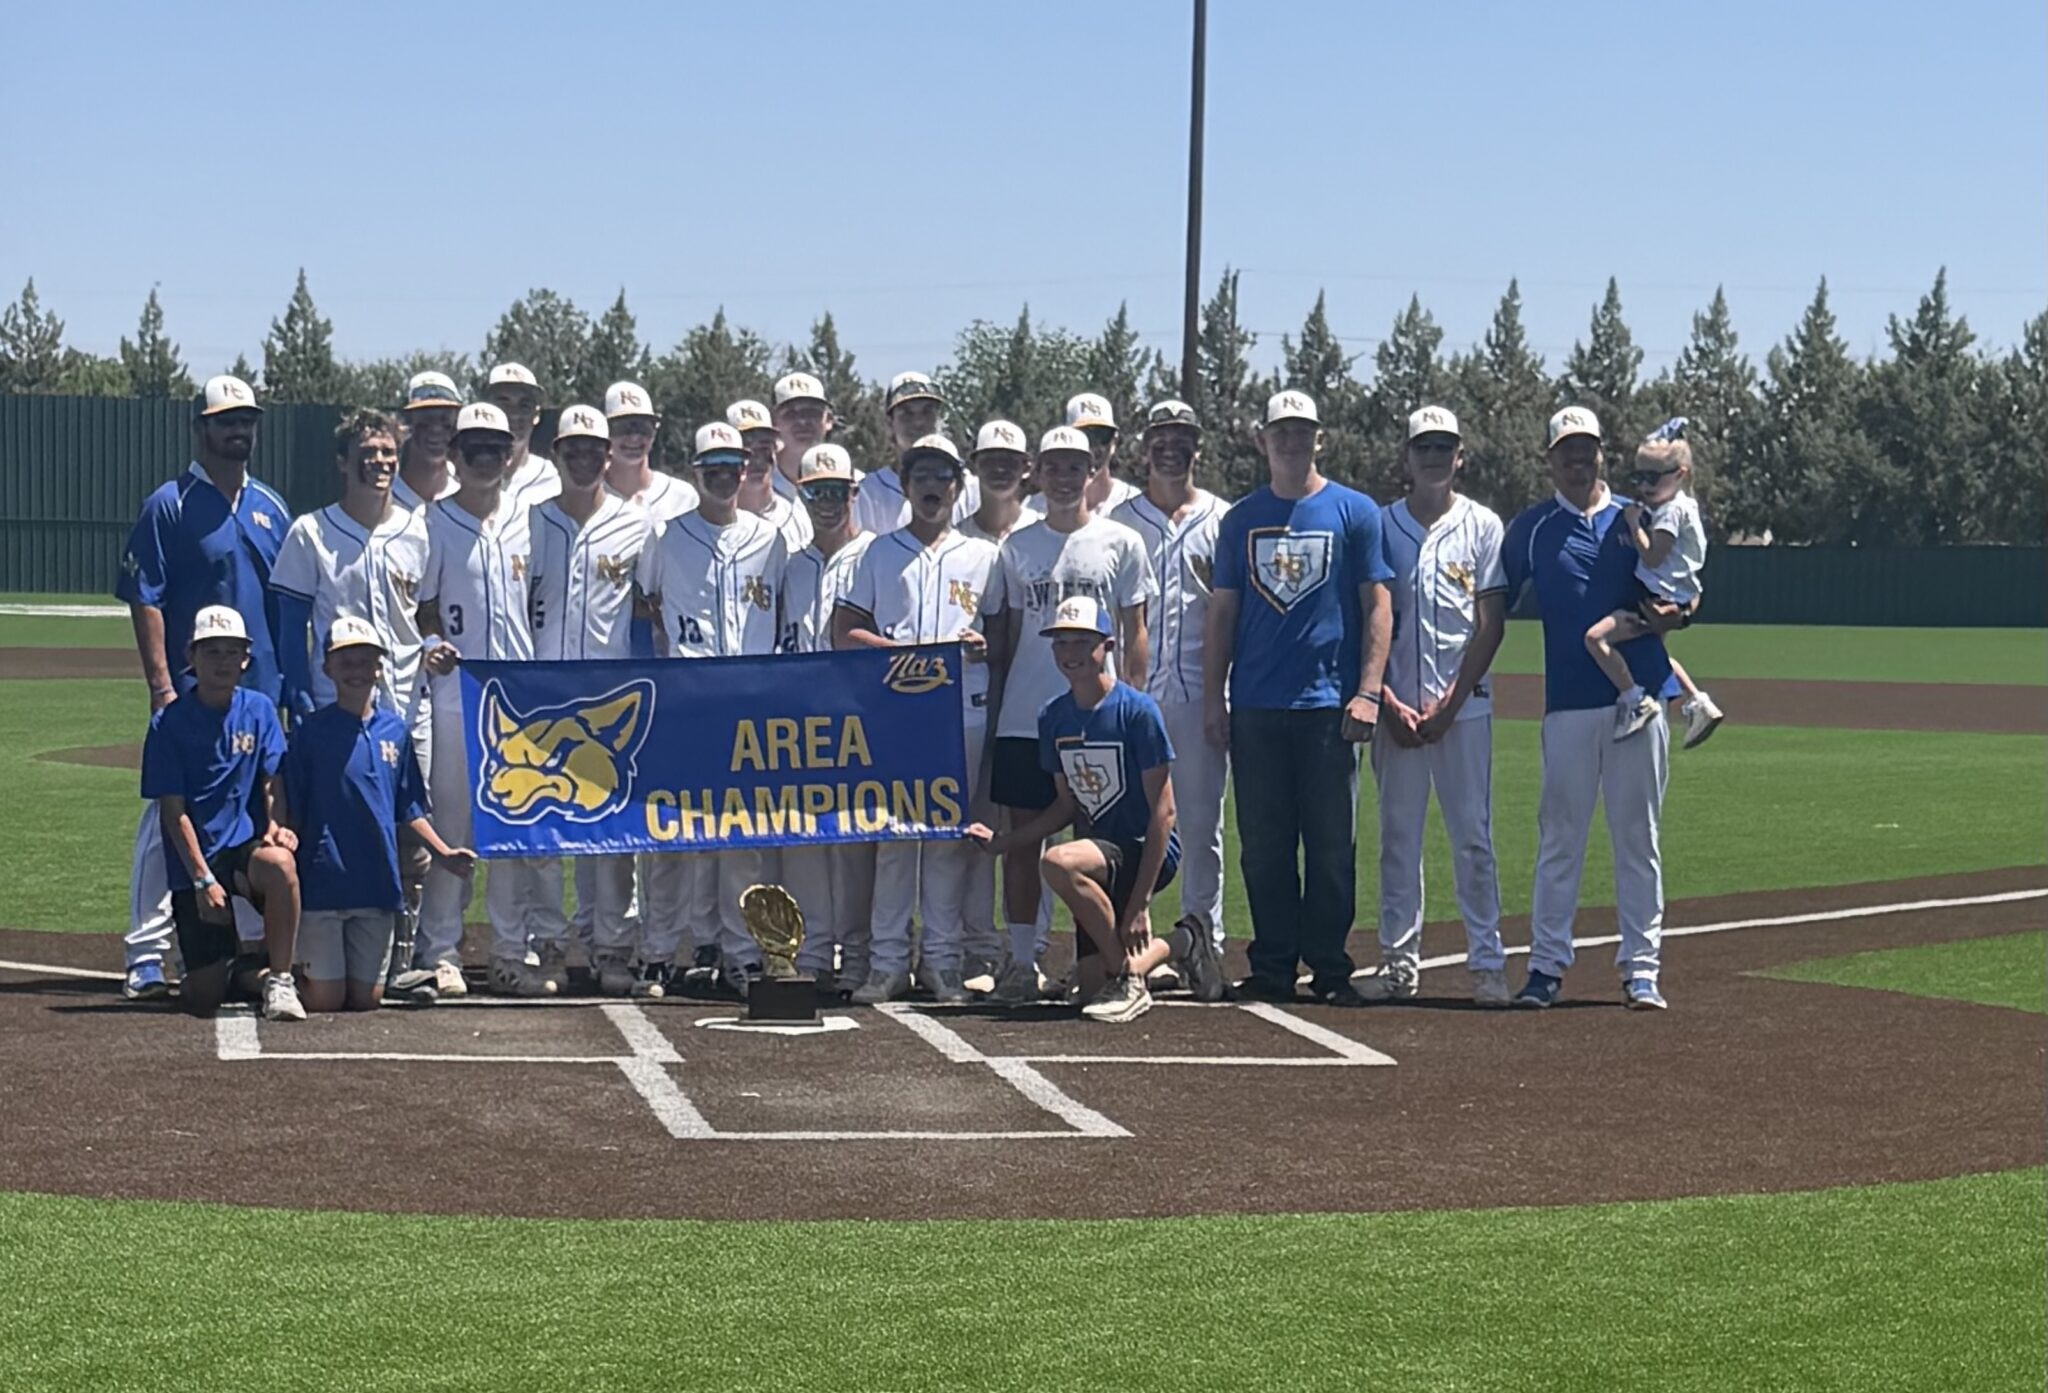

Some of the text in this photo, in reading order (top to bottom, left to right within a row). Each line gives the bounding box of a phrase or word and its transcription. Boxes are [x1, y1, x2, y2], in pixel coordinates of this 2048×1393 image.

[448, 604, 464, 635] 3
[730, 715, 872, 772] AREA
[646, 777, 962, 841] CHAMPIONS
